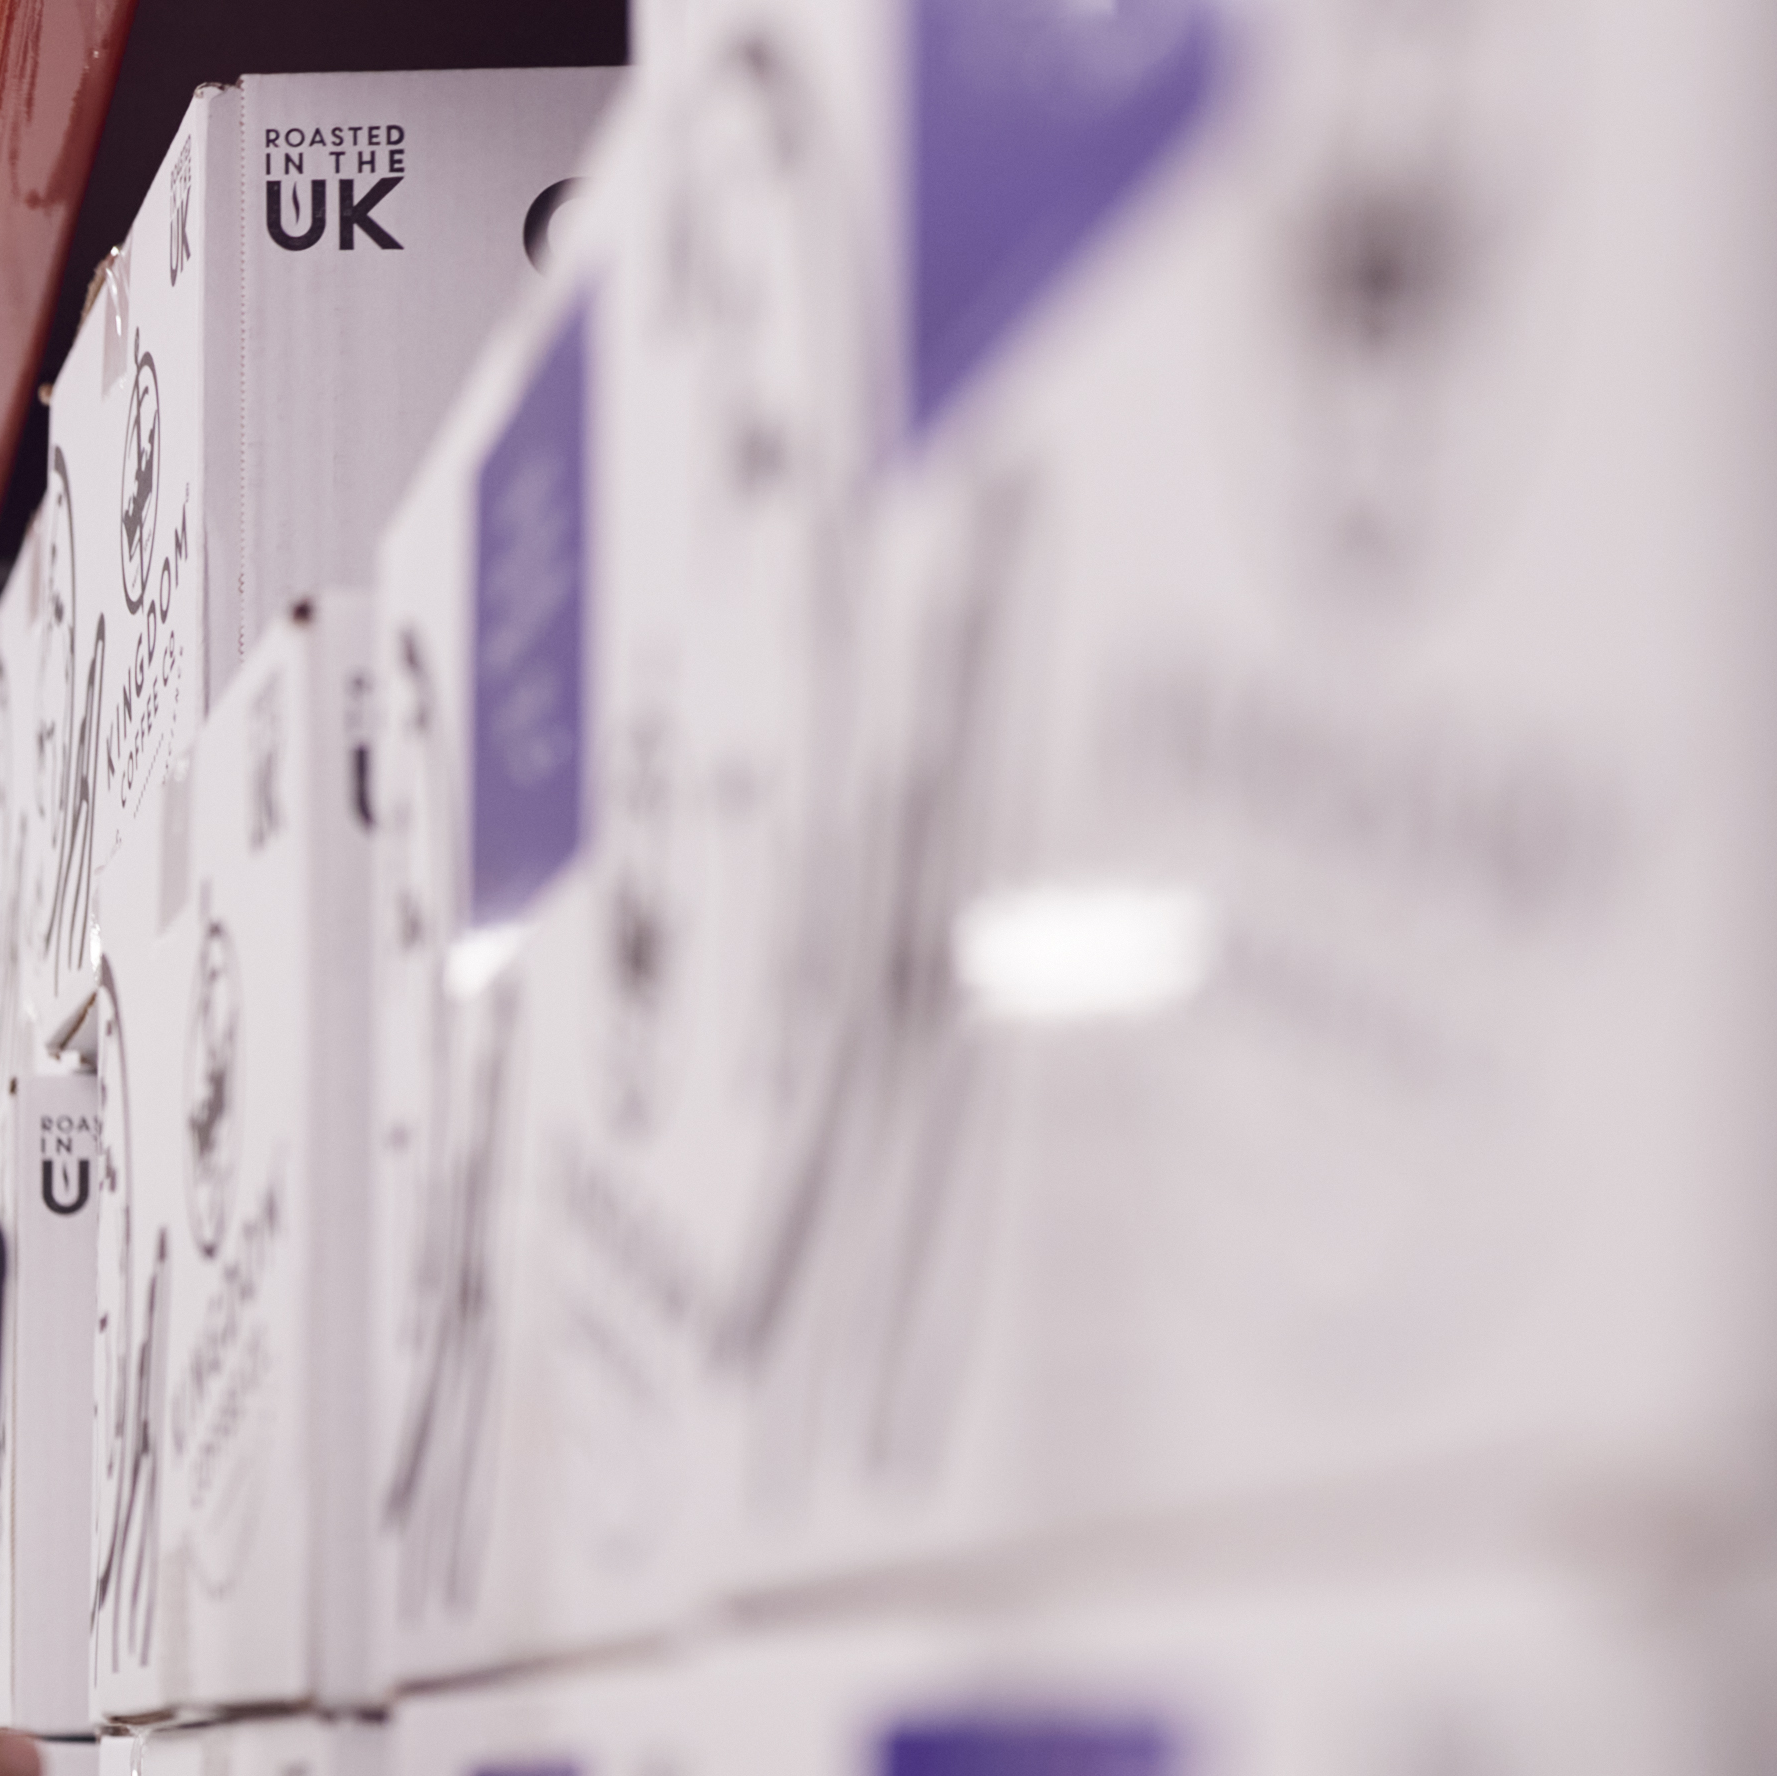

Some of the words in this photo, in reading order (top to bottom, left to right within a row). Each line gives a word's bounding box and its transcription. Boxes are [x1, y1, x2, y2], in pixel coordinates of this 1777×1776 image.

[265, 125, 405, 148] ROASTED
[265, 152, 304, 175] IN
[328, 148, 405, 174] THE
[170, 184, 191, 287] UK
[265, 176, 405, 251] UK
[106, 503, 188, 791] KINGDOM
[120, 675, 159, 809] COFFEE
[41, 1136, 72, 1155] IN
[42, 1158, 90, 1215] U
